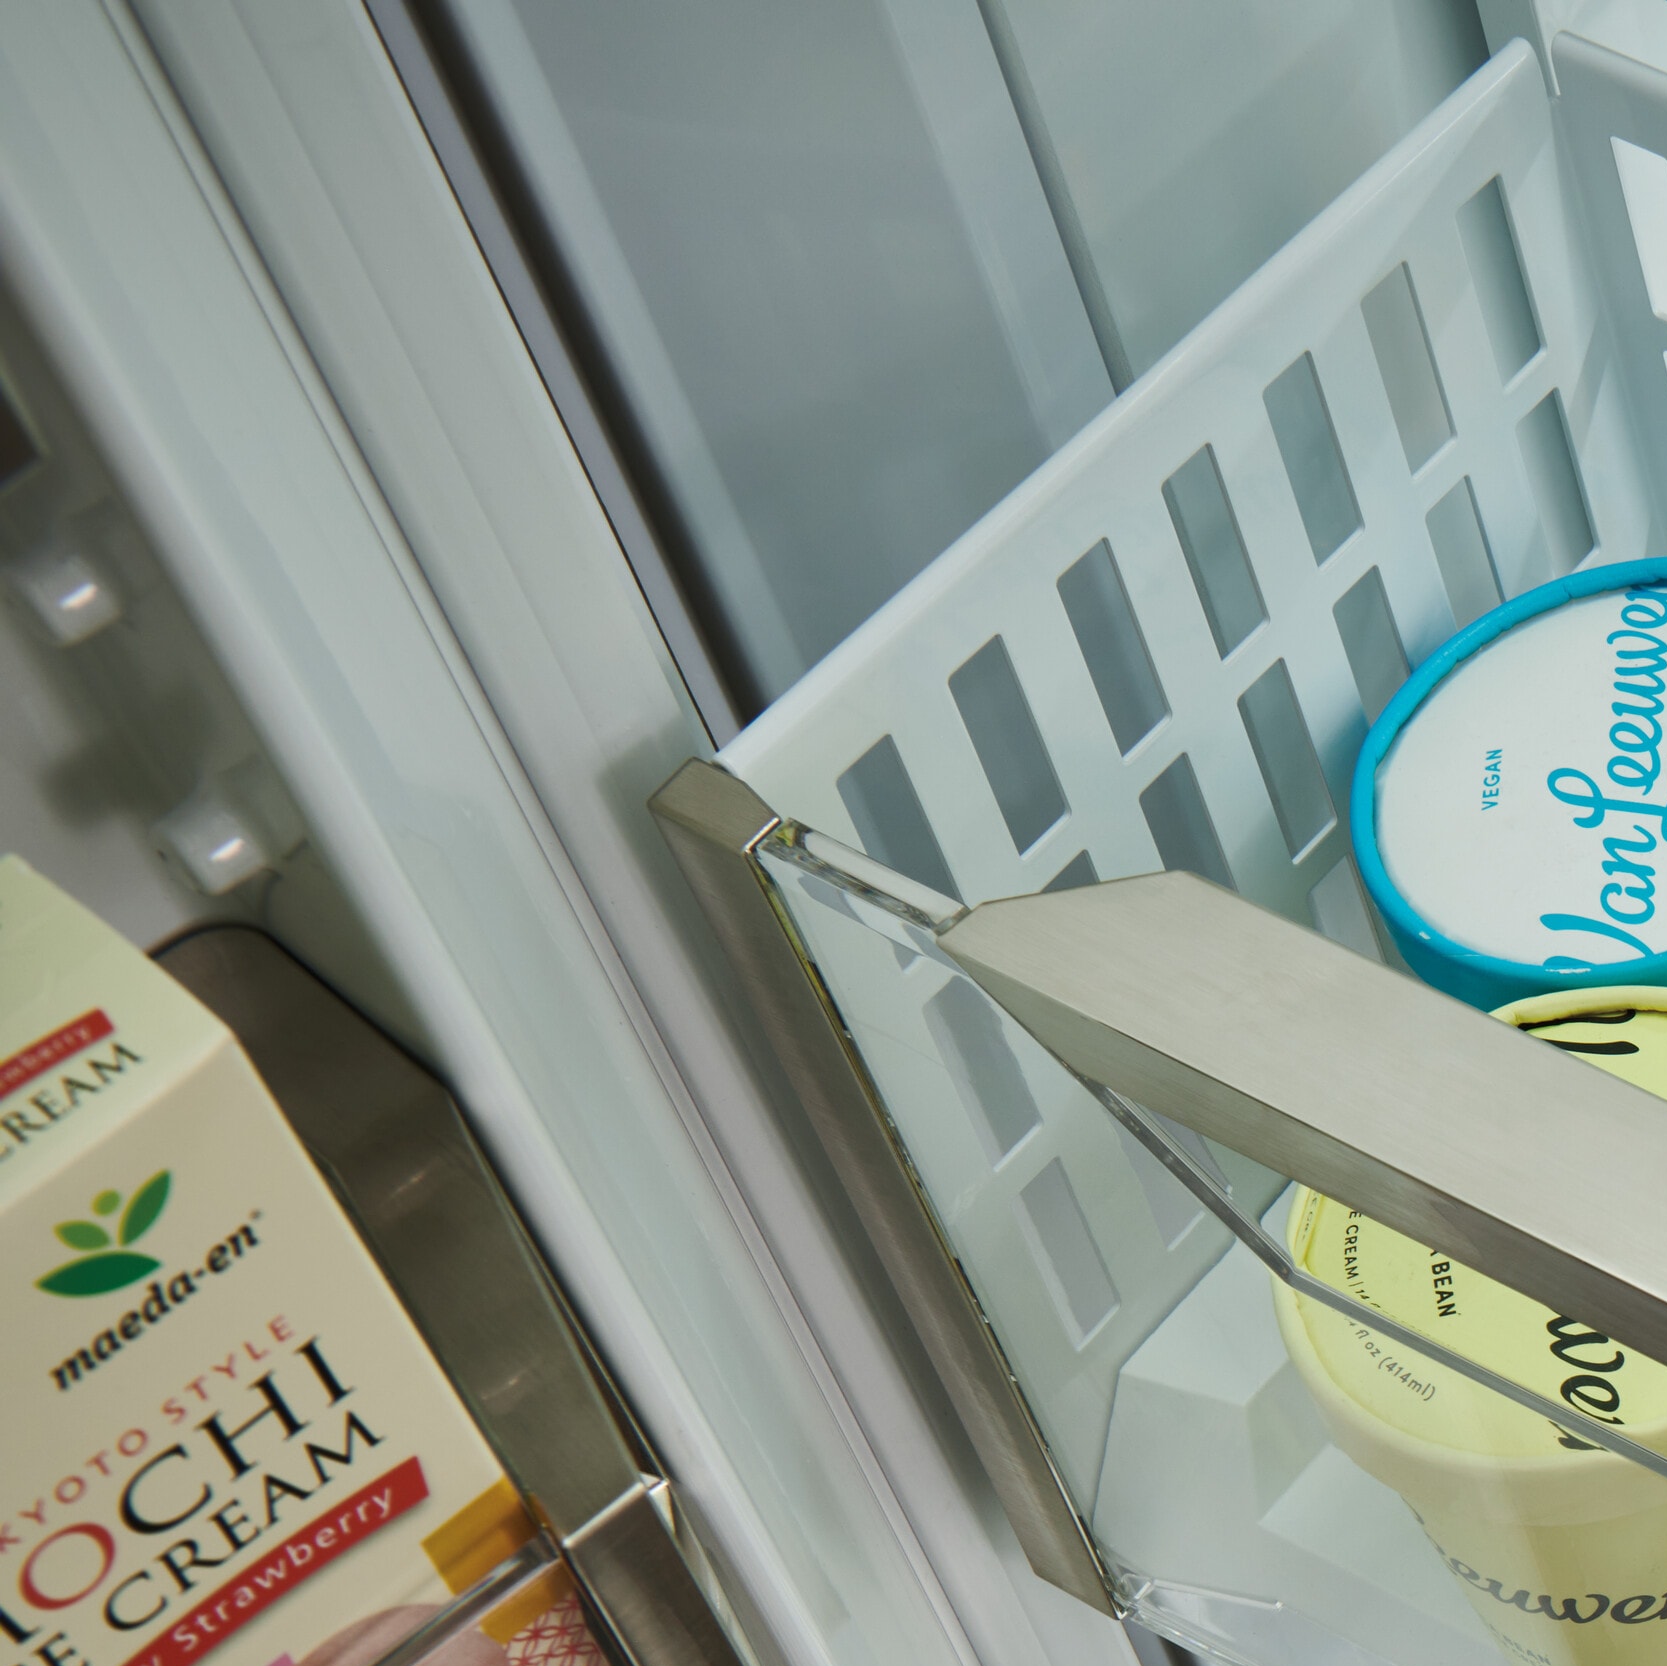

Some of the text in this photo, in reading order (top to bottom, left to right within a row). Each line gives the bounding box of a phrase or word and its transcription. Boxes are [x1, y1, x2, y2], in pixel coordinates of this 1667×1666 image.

[1481, 748, 1503, 811] VEGAN
[0, 1041, 143, 1163] REAM
[49, 1222, 261, 1393] maeda-en
[1344, 1224, 1360, 1280] CREAM
[1431, 1260, 1457, 1318] BEAN
[161, 1314, 295, 1425] STYLE
[1377, 1355, 1437, 1402] (414ml)
[102, 1410, 387, 1632] CREAM
[172, 1486, 394, 1653] Strawberry
